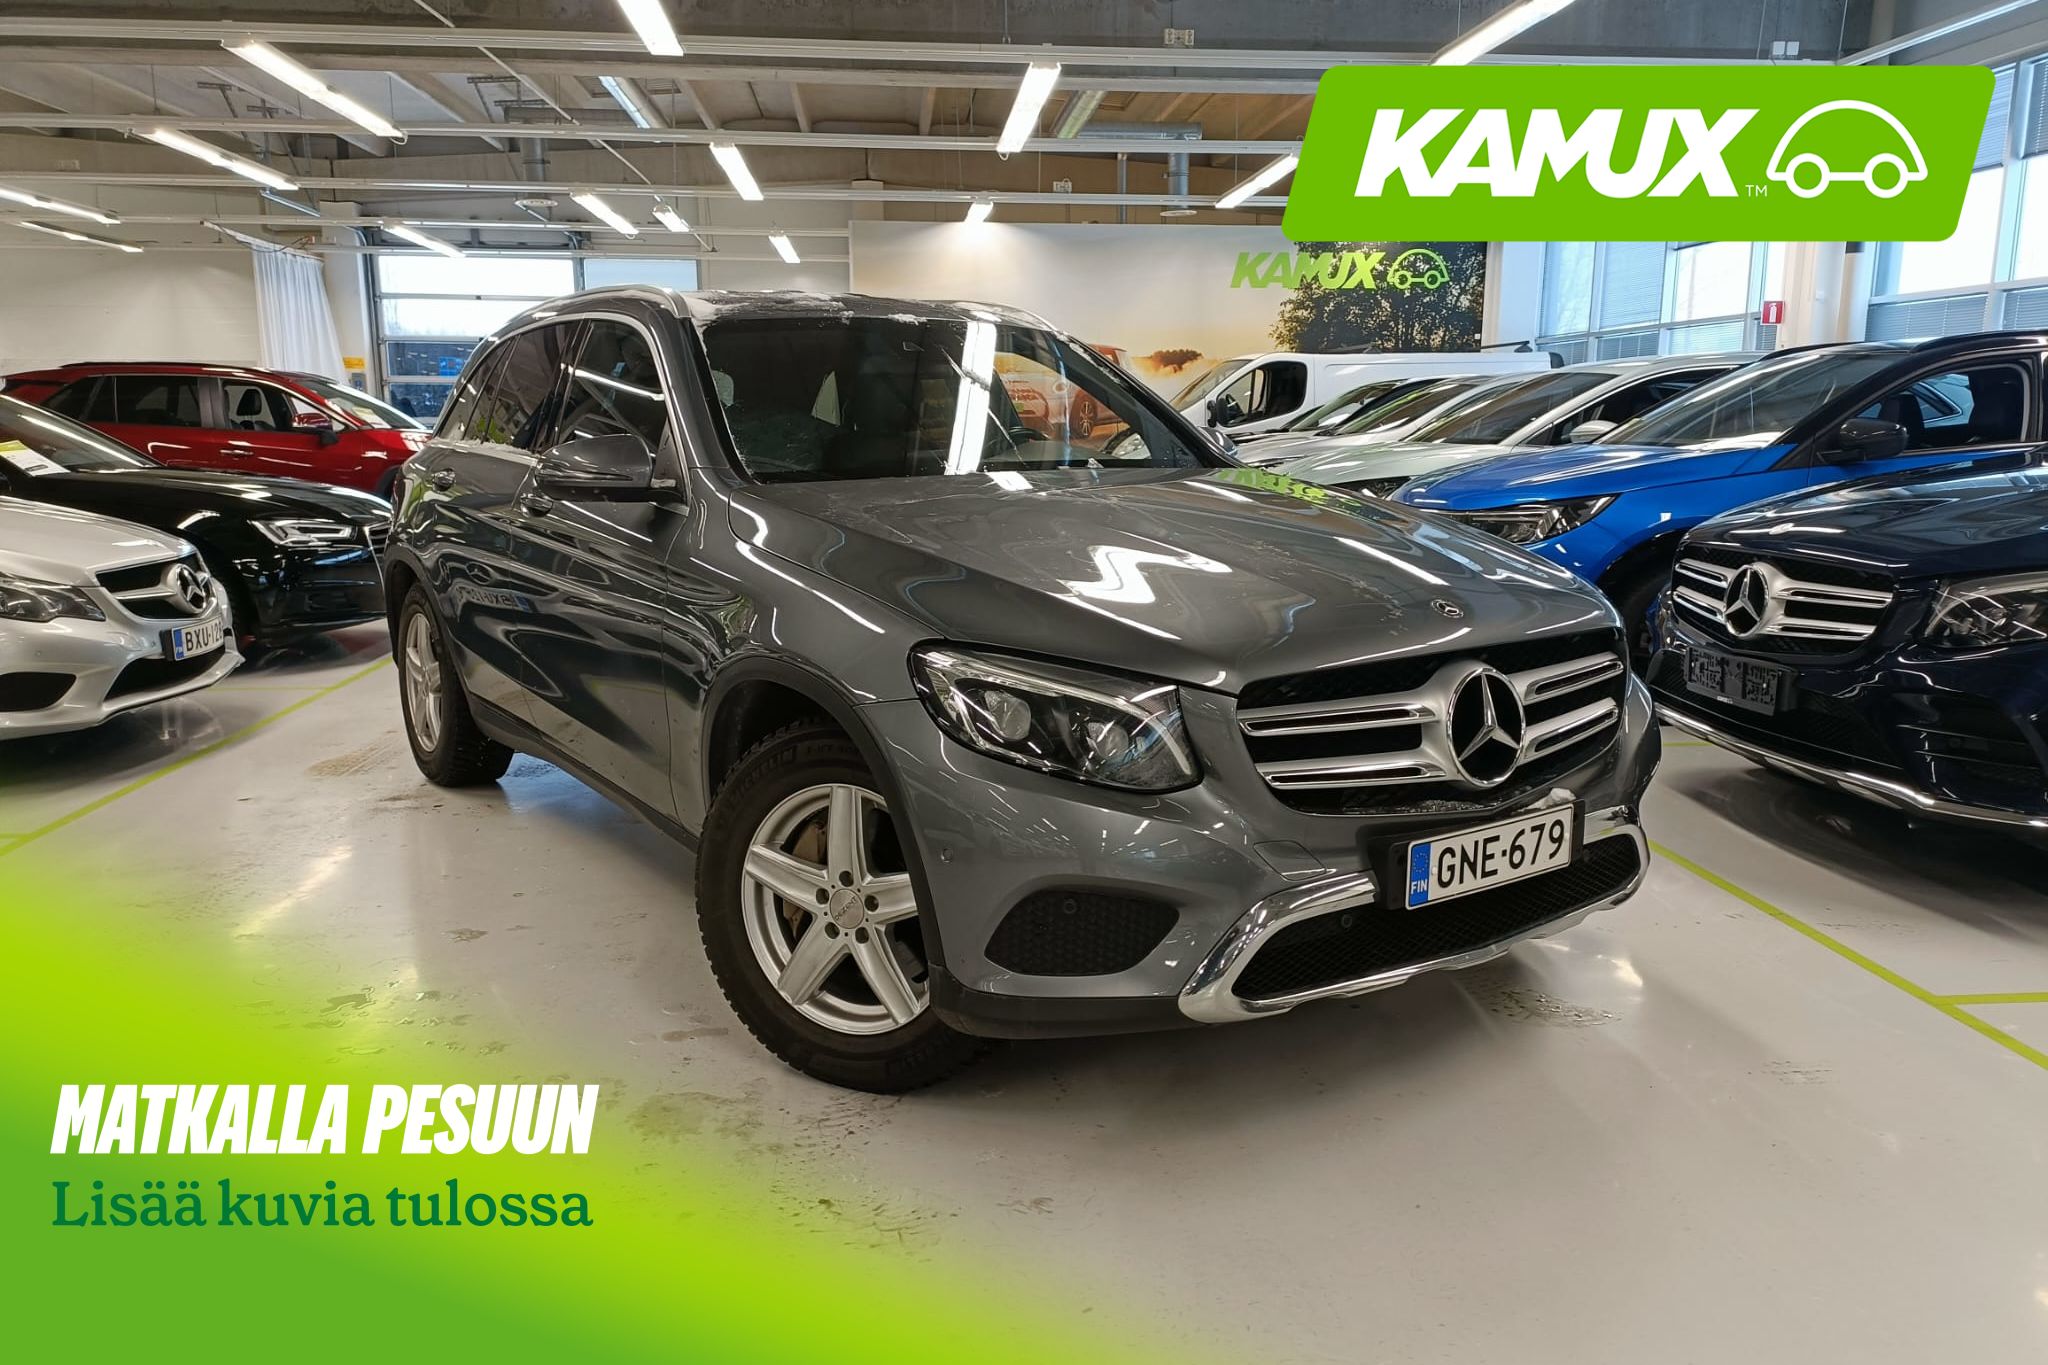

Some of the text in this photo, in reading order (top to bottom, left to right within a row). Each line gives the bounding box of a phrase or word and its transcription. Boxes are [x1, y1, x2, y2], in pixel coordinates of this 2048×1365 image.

[1230, 251, 1386, 289] KAMUX
[1437, 818, 1565, 889] GNE-679
[1410, 878, 1429, 895] FIN
